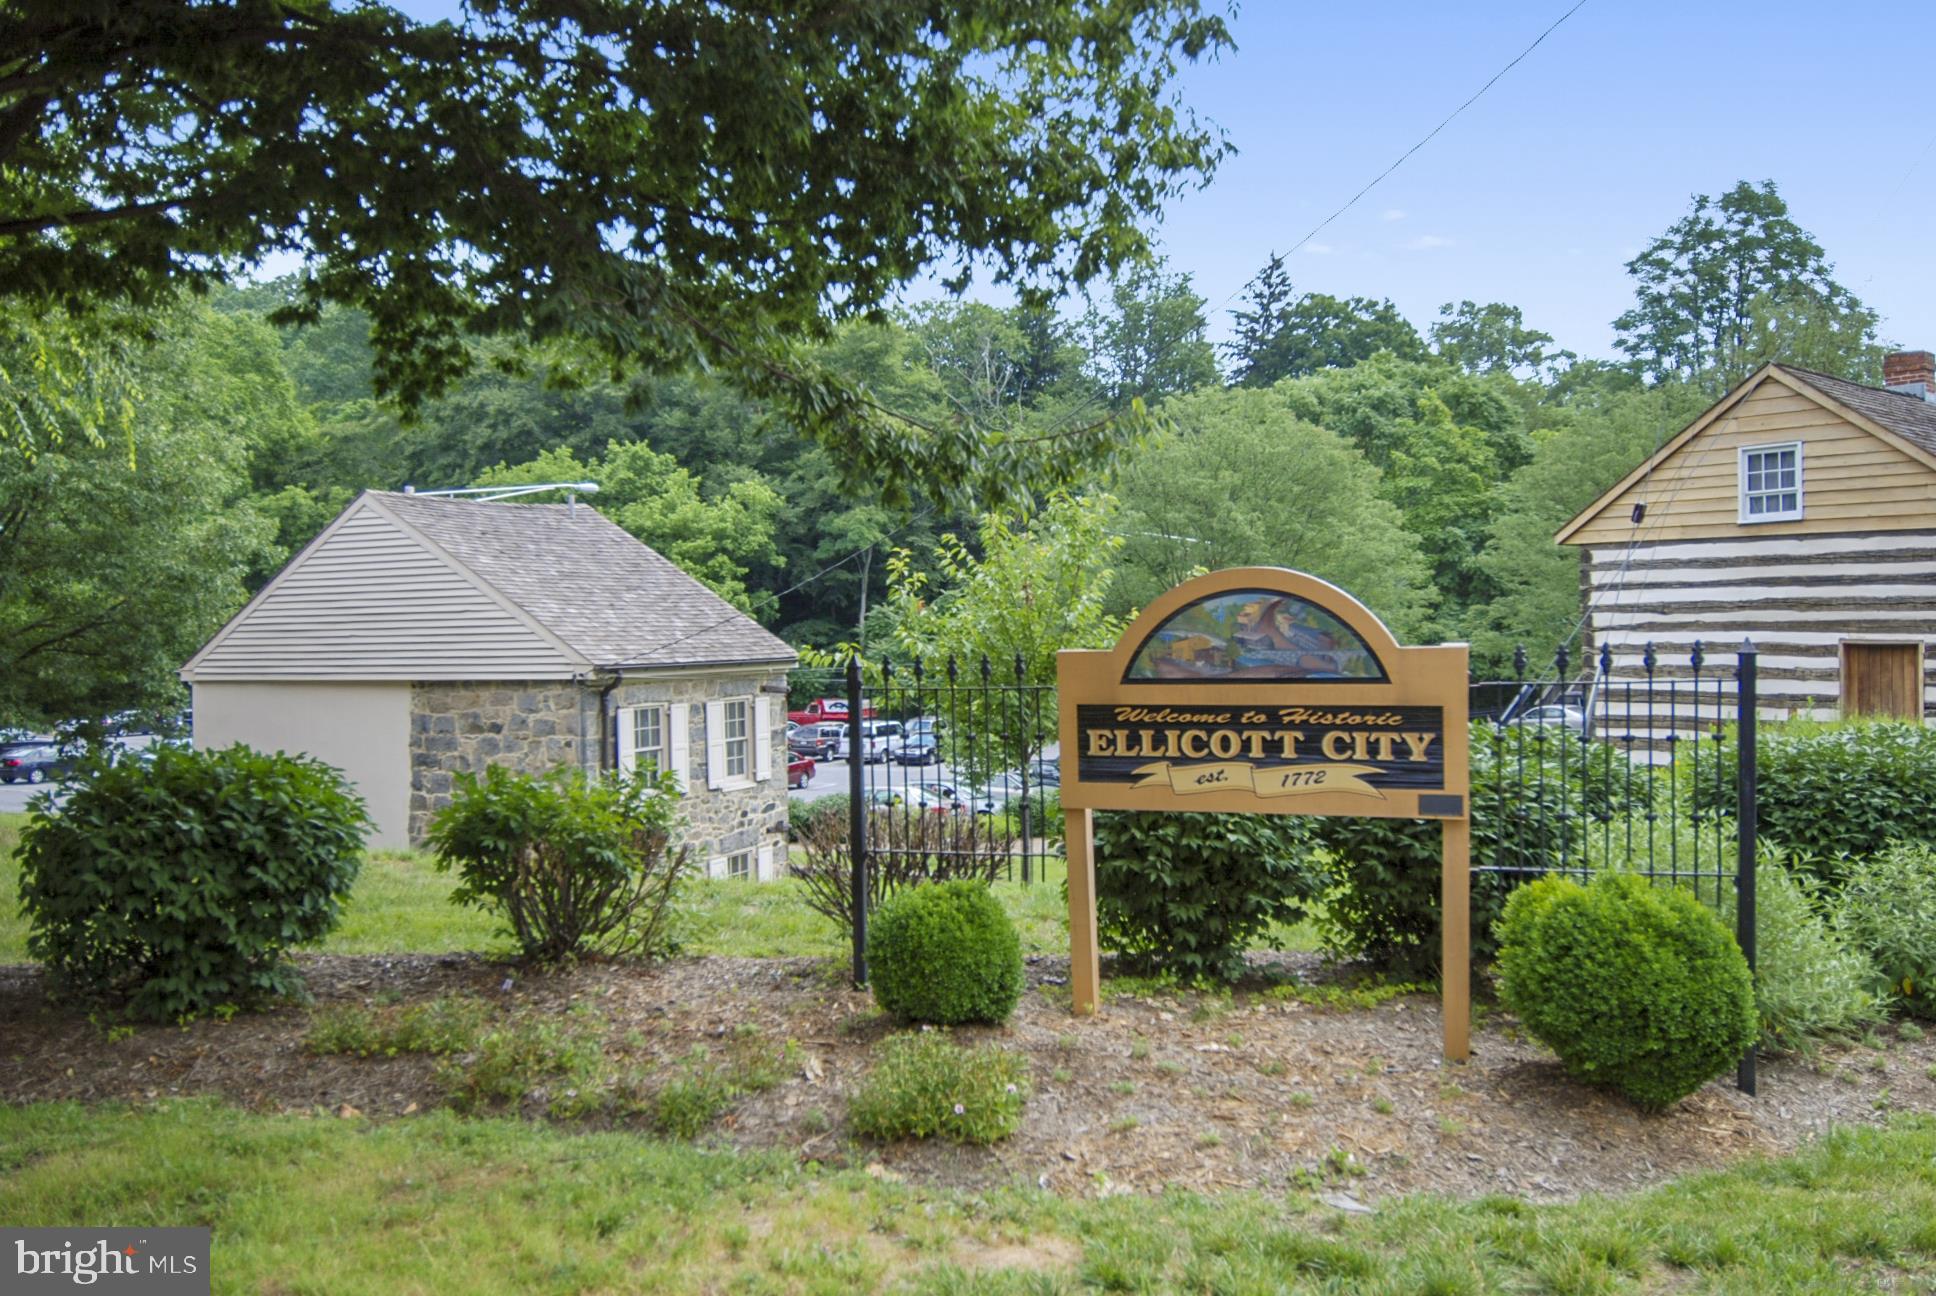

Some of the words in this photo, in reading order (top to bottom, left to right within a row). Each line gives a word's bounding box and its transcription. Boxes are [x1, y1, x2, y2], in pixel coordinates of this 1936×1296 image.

[1113, 706, 1231, 725] Welcome
[1240, 711, 1266, 725] to
[1278, 708, 1405, 726] Historic
[1086, 729, 1304, 759] ELLICOTT
[1321, 731, 1435, 762] CITY
[1195, 770, 1229, 784] est.
[1280, 770, 1327, 788] 1772
